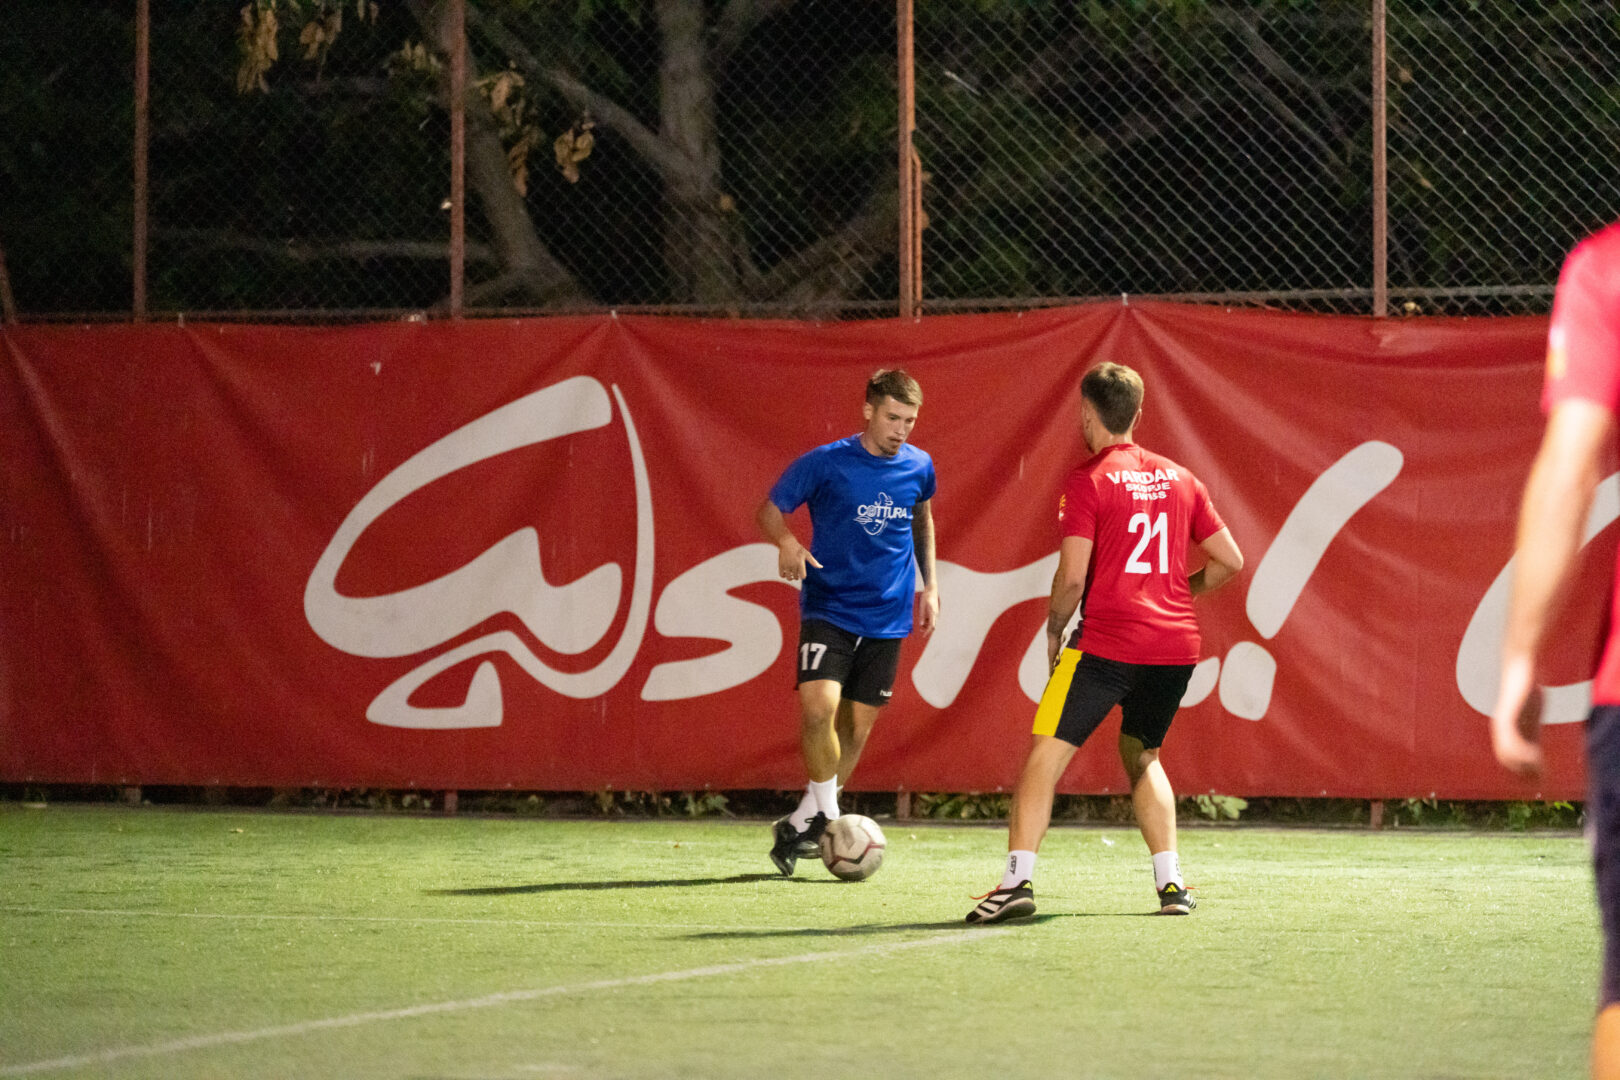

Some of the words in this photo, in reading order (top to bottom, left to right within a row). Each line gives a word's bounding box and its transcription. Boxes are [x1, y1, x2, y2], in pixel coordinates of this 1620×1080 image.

[1105, 468, 1180, 485] VARDAR
[1124, 511, 1169, 574] 21
[800, 642, 827, 671] 17
